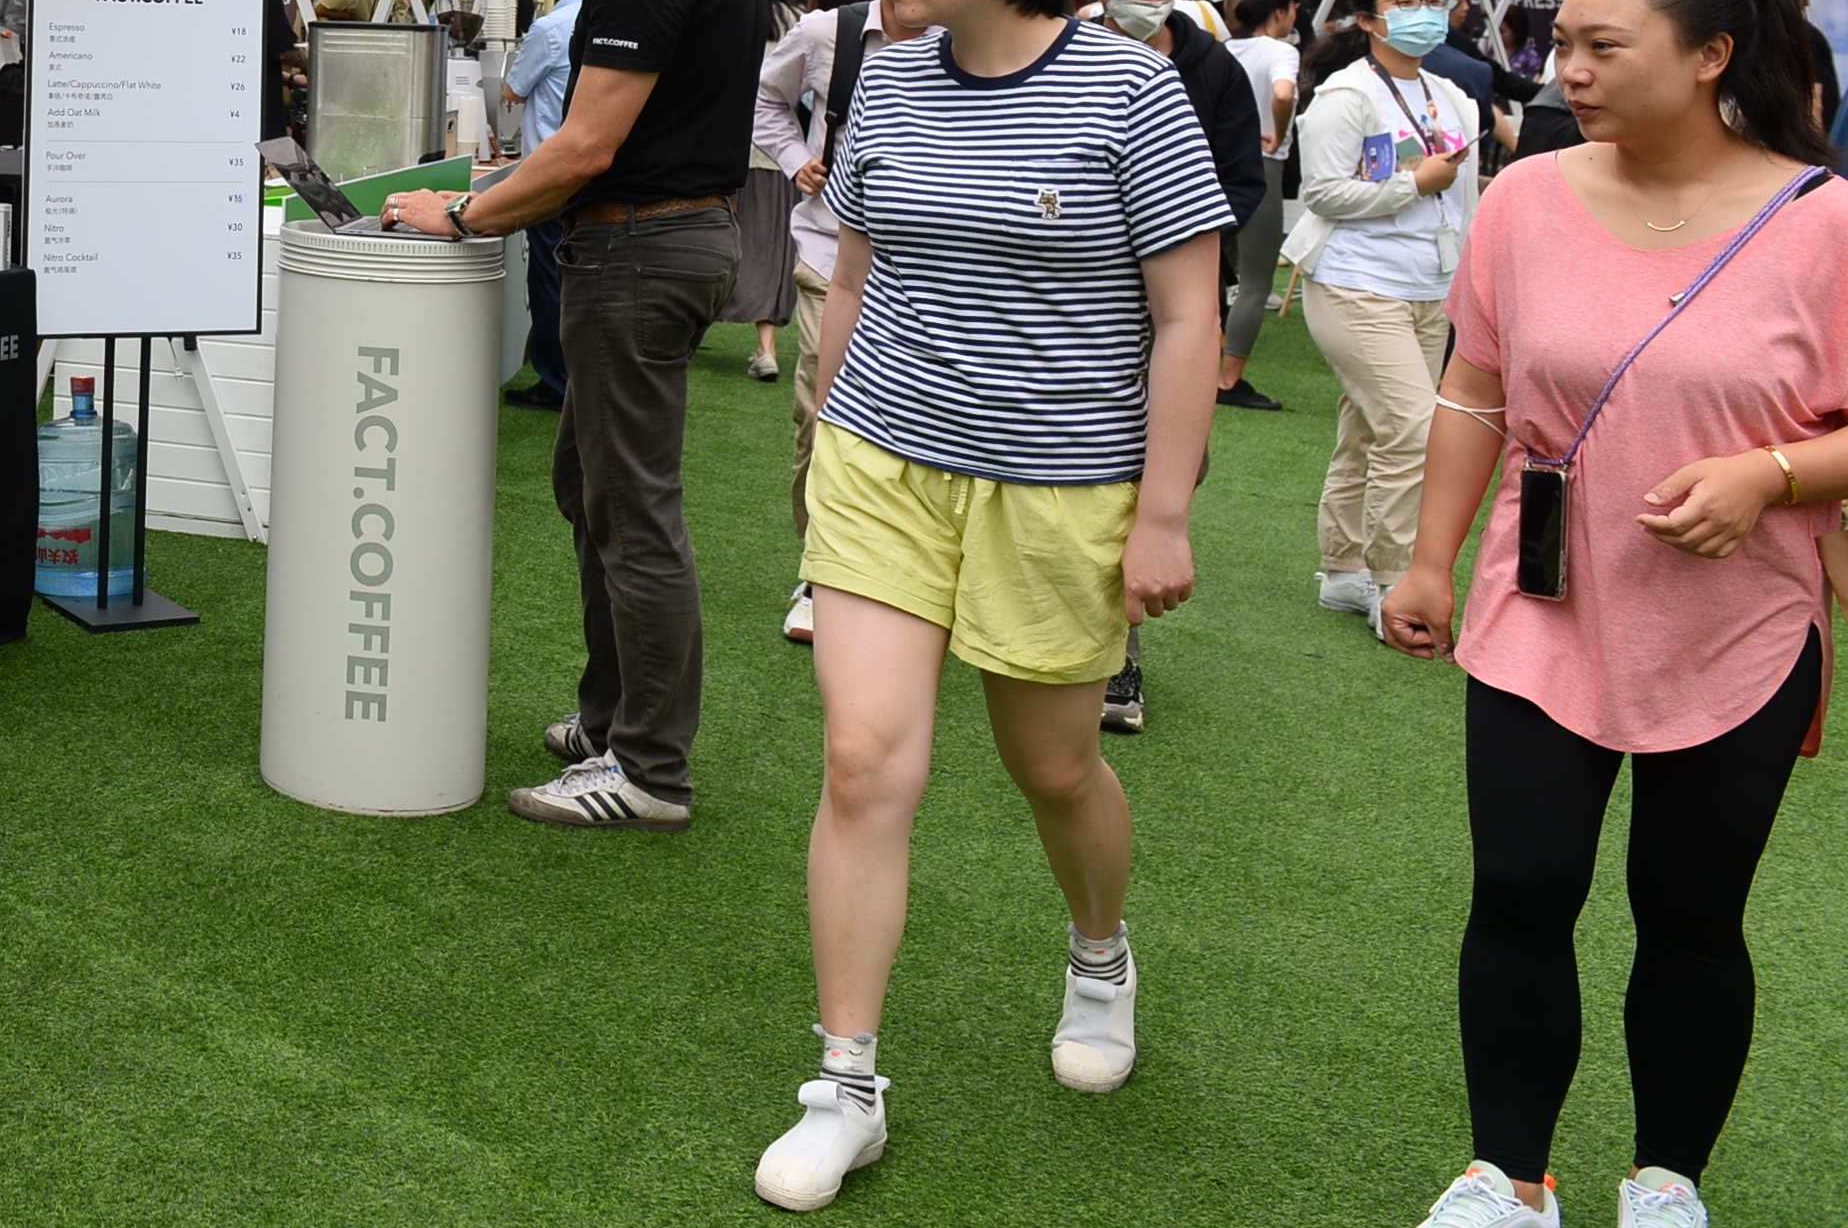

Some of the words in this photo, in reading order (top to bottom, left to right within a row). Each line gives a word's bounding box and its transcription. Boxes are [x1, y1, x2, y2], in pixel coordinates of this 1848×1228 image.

[49, 23, 85, 35] Espresso
[231, 27, 247, 37] ¥18
[593, 38, 639, 50] FACT.COFFEE
[49, 52, 93, 61] Americano
[231, 55, 246, 64] ¥22
[49, 64, 62, 72] 美式
[48, 80, 137, 92] Latte/Cappuccino/Flat
[138, 81, 162, 91] White
[231, 83, 246, 92] ¥26
[47, 108, 66, 118] Add
[67, 109, 83, 118] Oat
[84, 108, 101, 118] Milk
[230, 110, 241, 119] ¥4
[46, 151, 64, 161] Pour
[66, 151, 86, 161] Over
[229, 158, 244, 167] ¥35
[45, 195, 74, 204] Aurora
[44, 224, 64, 233] Nitro
[228, 223, 243, 232] ¥30
[43, 253, 64, 262] Nitro
[65, 252, 98, 262] Cocktail
[227, 252, 242, 261] ¥35
[345, 346, 399, 722] FACT.COFFEE
